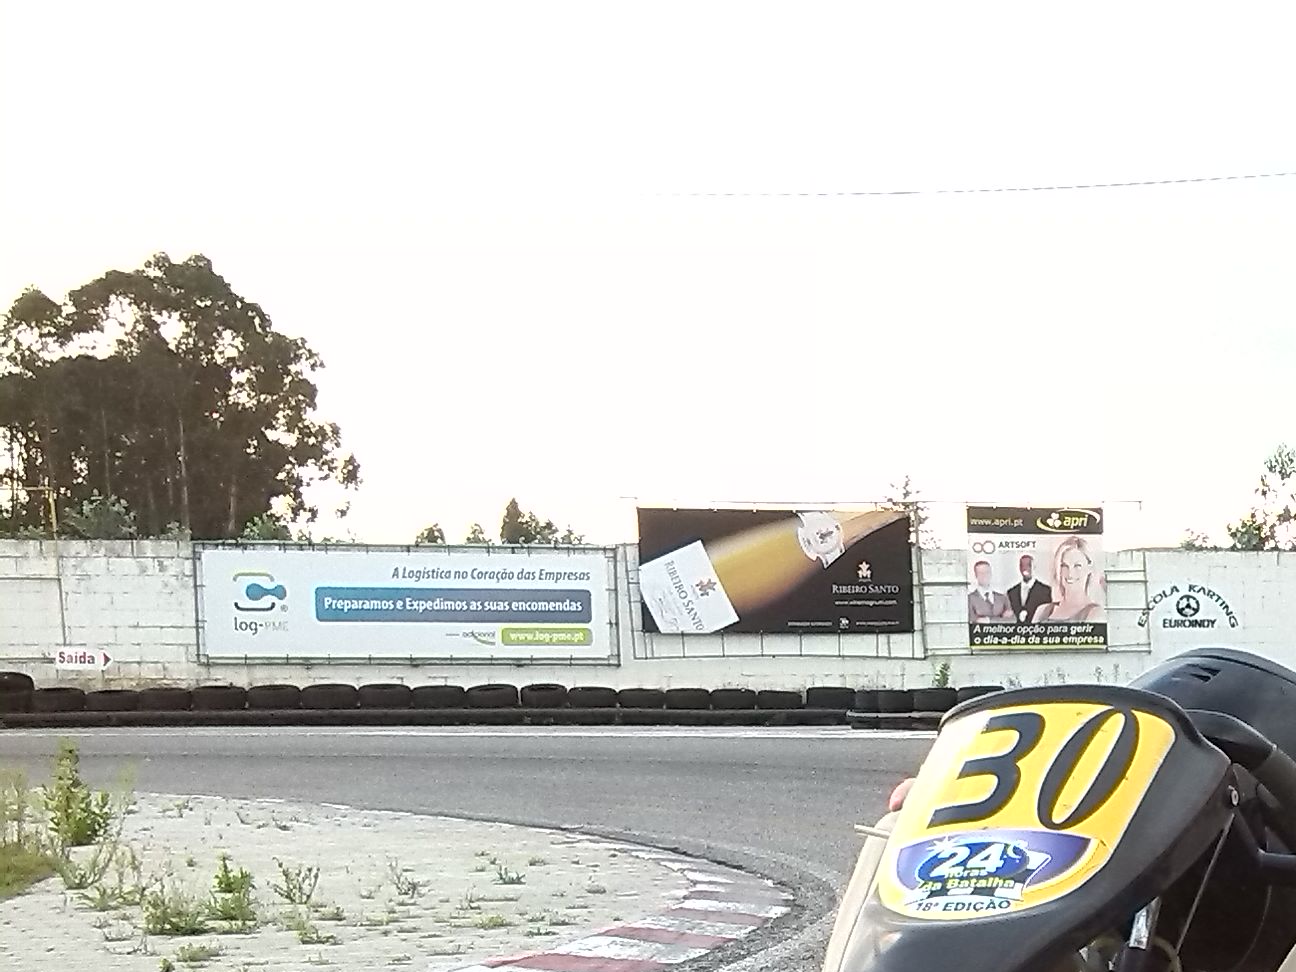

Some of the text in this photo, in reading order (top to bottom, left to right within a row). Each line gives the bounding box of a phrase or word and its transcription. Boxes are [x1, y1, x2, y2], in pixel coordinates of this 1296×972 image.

[970, 514, 1089, 529] www.apri.pt apri
[998, 540, 1036, 549] ARTSOFT
[392, 567, 399, 579] A
[454, 571, 468, 580] no
[470, 568, 514, 583] Coração
[517, 569, 536, 581] das
[538, 569, 591, 583] Empresas
[664, 560, 688, 600] RIBEIRO
[682, 600, 705, 631] SANTO
[832, 584, 900, 594] RIBEIRO SANTO
[324, 597, 583, 613] Preparamos e Expedimos as suas encomendas
[1137, 584, 1239, 628] ESCOLA KARTING
[973, 624, 1094, 635] A melhor opção para gerir
[1162, 618, 1217, 629] EUROINDY
[509, 632, 584, 643] www.log-pme.pt
[983, 635, 1026, 645] dia-a-dia
[1028, 635, 1040, 645] da
[1042, 636, 1061, 644] sua
[1062, 635, 1105, 646] empresa
[927, 706, 1140, 830] 30
[929, 842, 1006, 878] 24
[919, 877, 1016, 892] da Batalha
[942, 898, 1012, 912] EDIÇÃO
